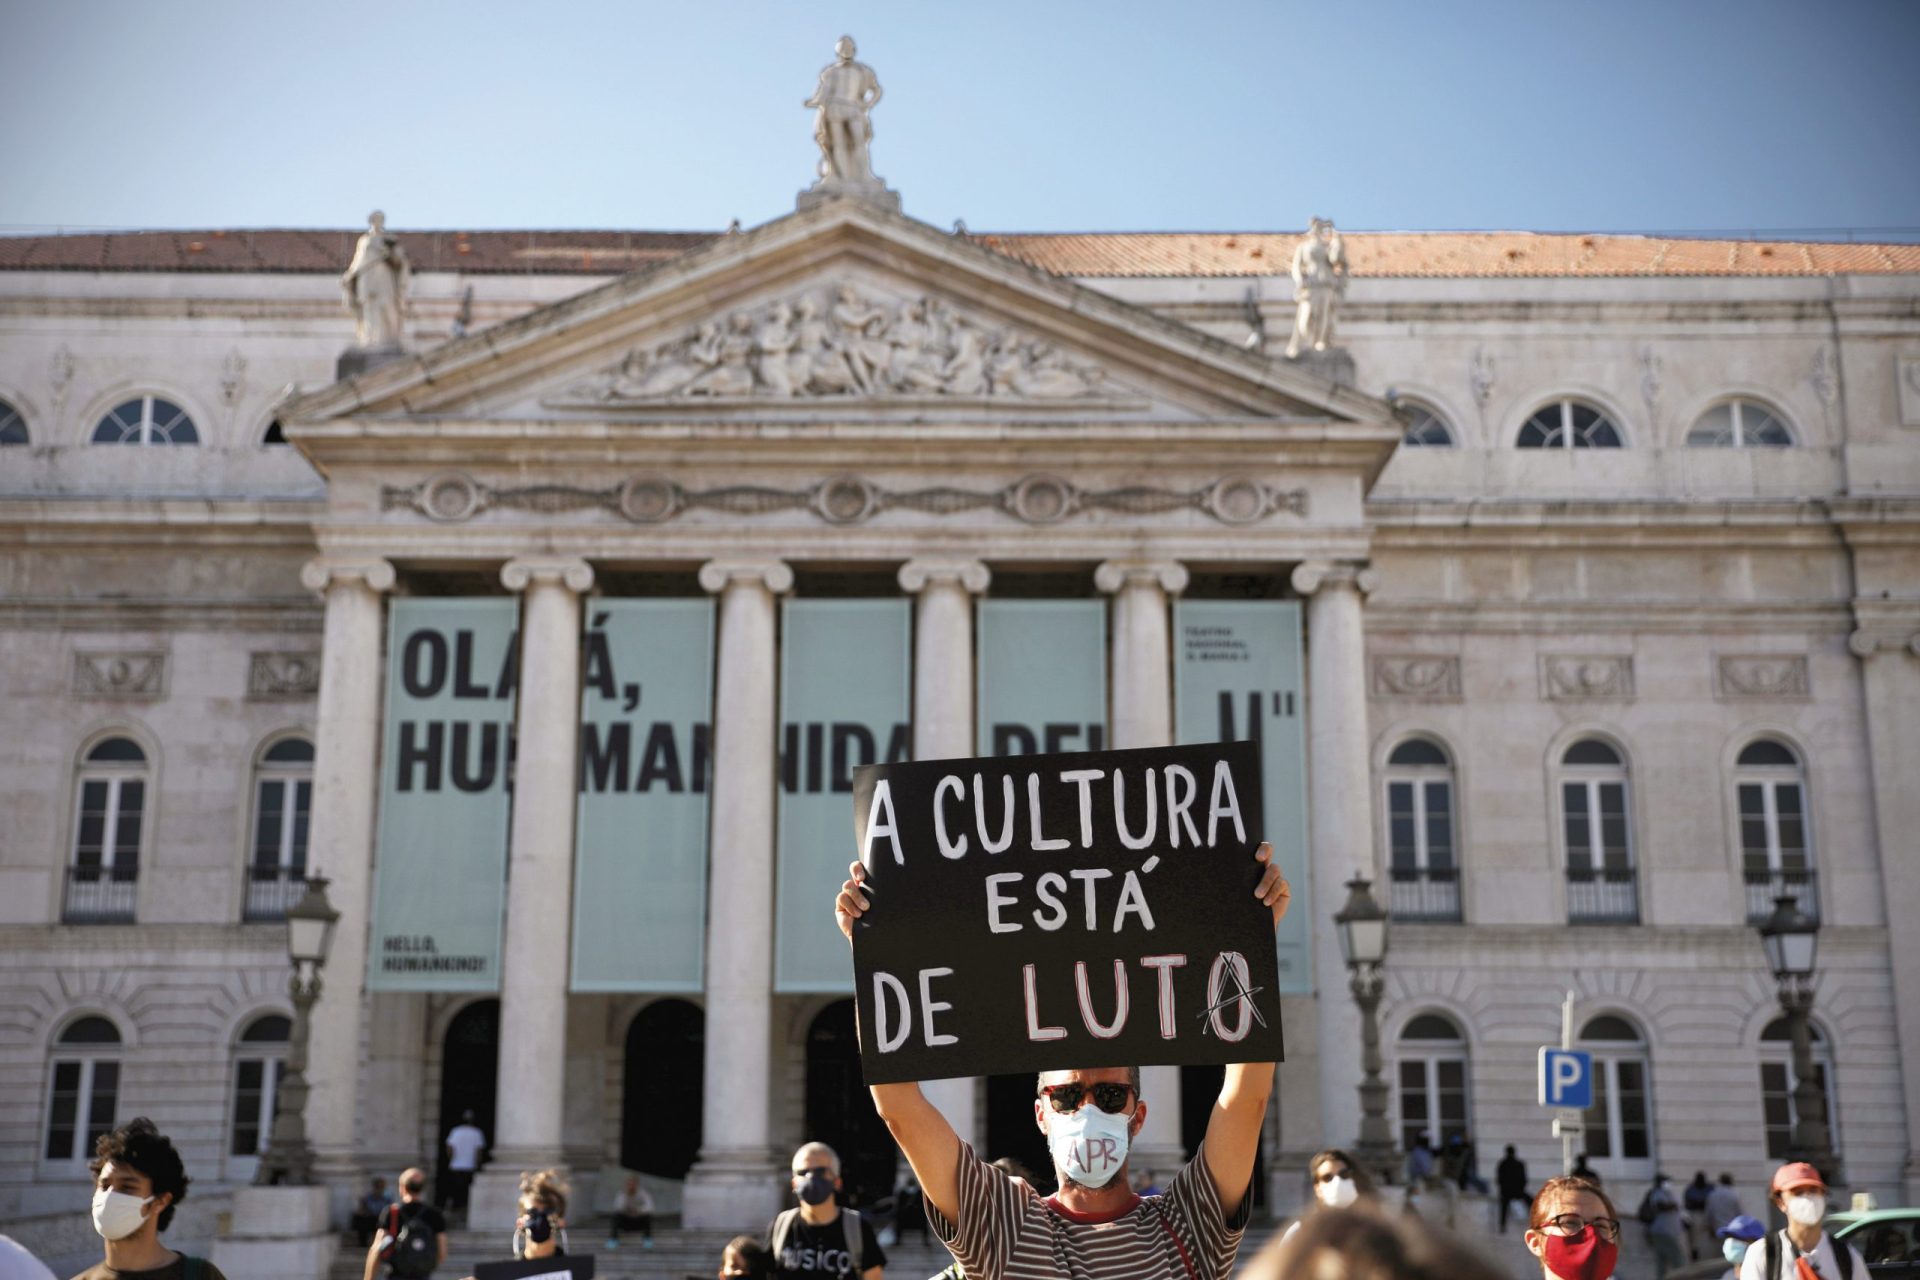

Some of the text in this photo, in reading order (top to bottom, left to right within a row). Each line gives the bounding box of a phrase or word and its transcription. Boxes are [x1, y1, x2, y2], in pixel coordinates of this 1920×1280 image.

[864, 760, 1247, 872] A CULTURA
[985, 855, 1161, 934] ESTÁ
[873, 967, 960, 1054] DE
[1551, 1055, 1583, 1102] P
[1067, 1138, 1119, 1174] APR
